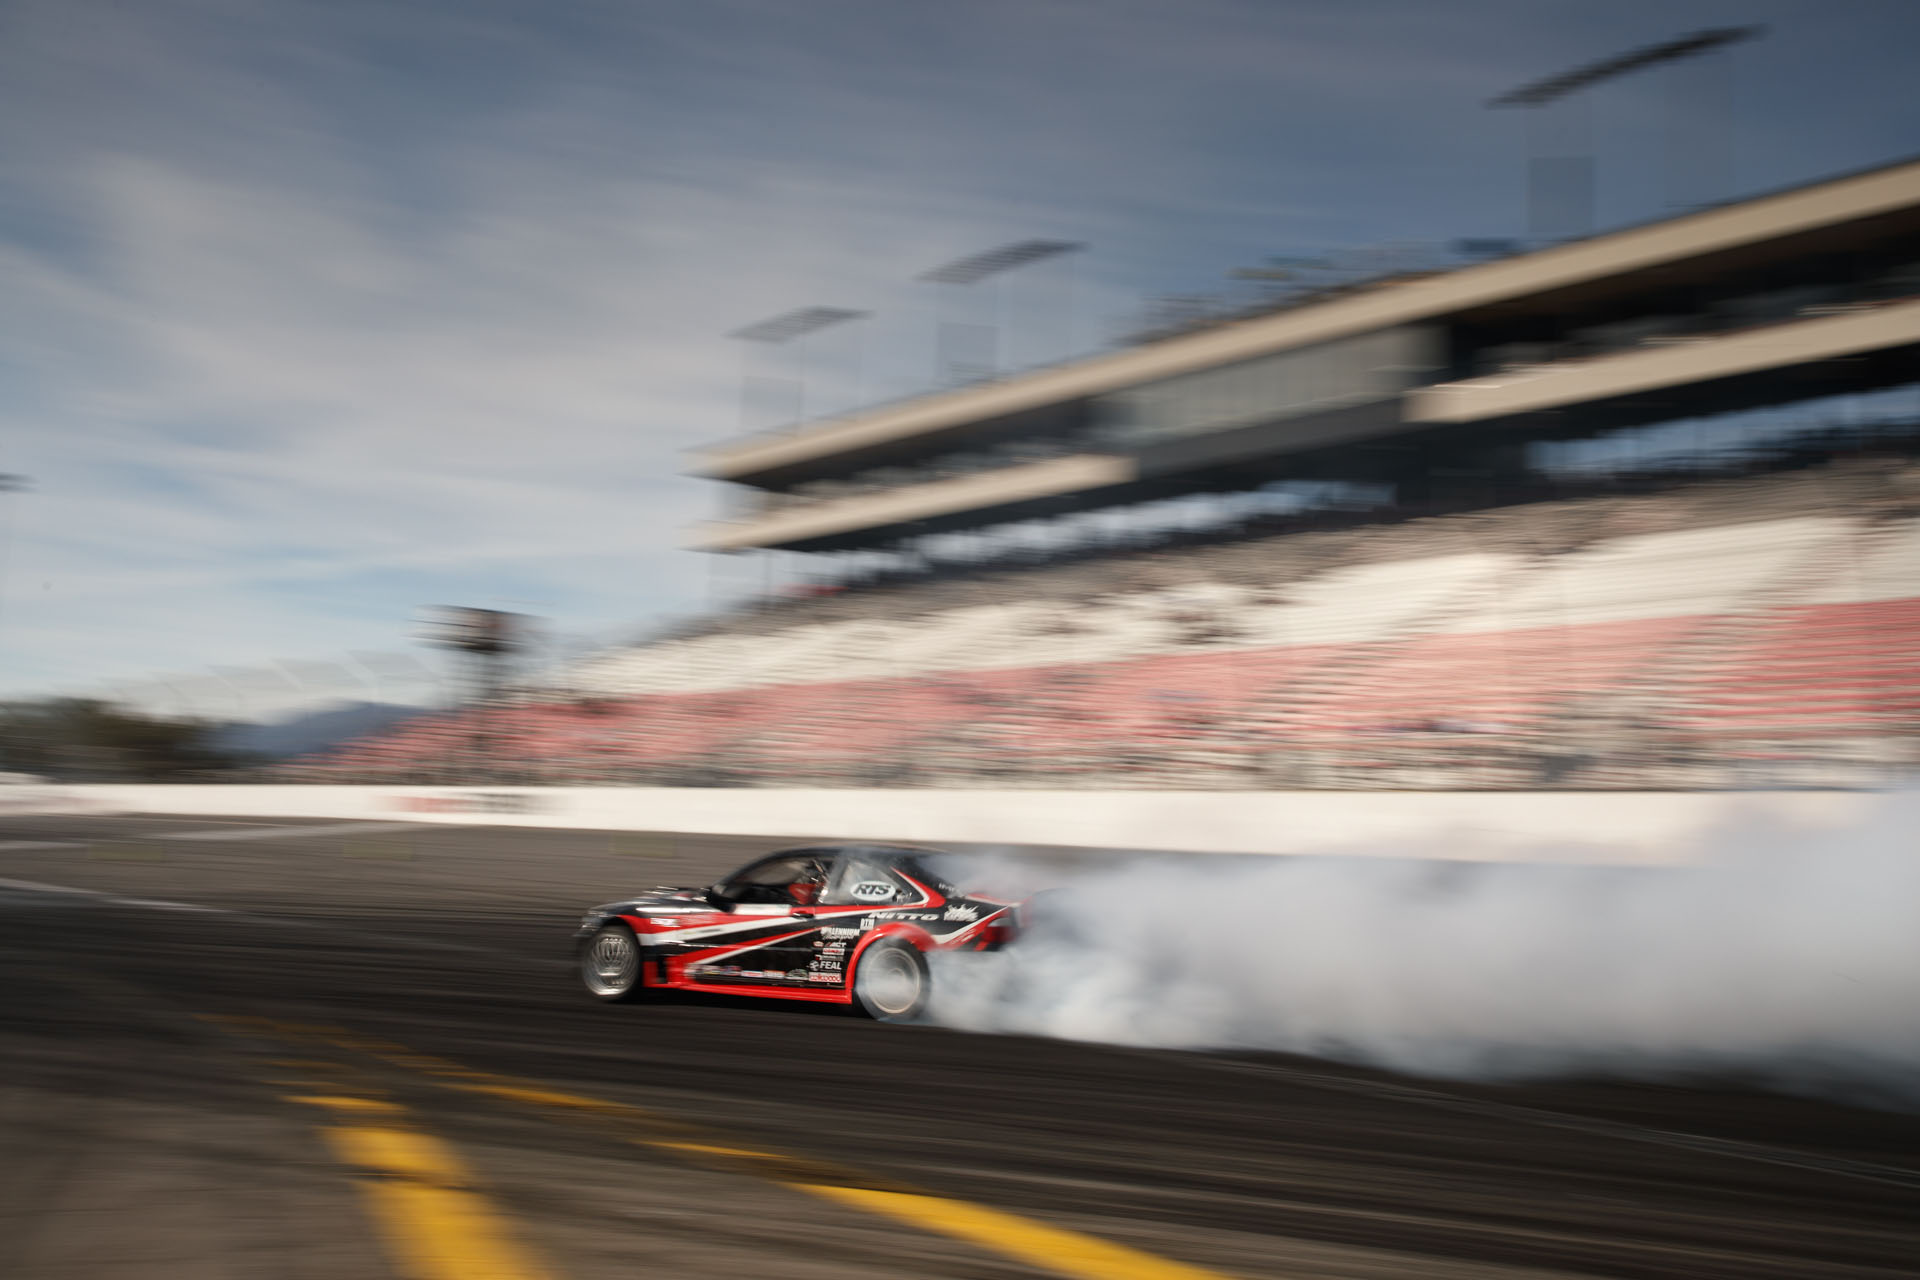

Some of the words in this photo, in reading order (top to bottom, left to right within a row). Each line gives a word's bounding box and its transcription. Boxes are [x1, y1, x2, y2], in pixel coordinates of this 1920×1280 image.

[854, 884, 891, 895] RTS
[868, 912, 939, 921] NITTO
[820, 961, 842, 970] FEAL
